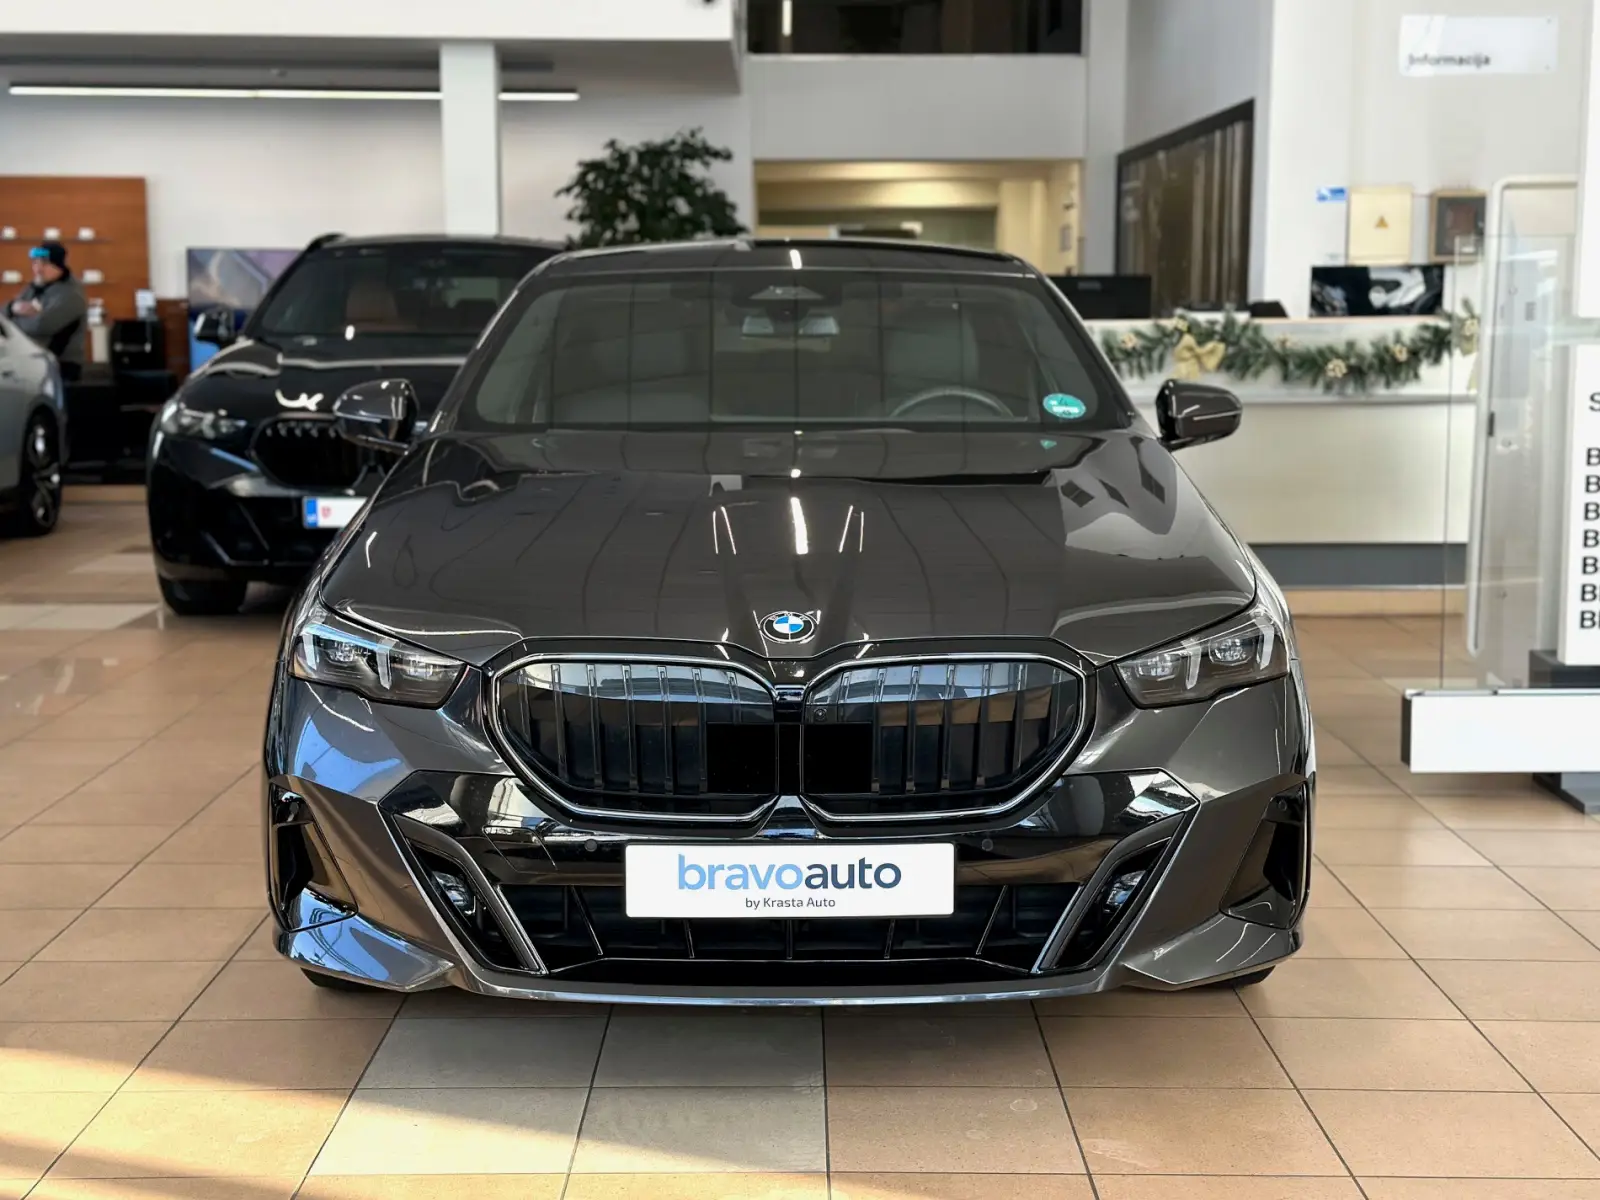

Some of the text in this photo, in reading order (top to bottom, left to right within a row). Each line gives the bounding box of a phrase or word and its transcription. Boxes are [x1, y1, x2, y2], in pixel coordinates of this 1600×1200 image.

[678, 853, 902, 891] bravoauto
[745, 896, 836, 911] by Krasta Auto
